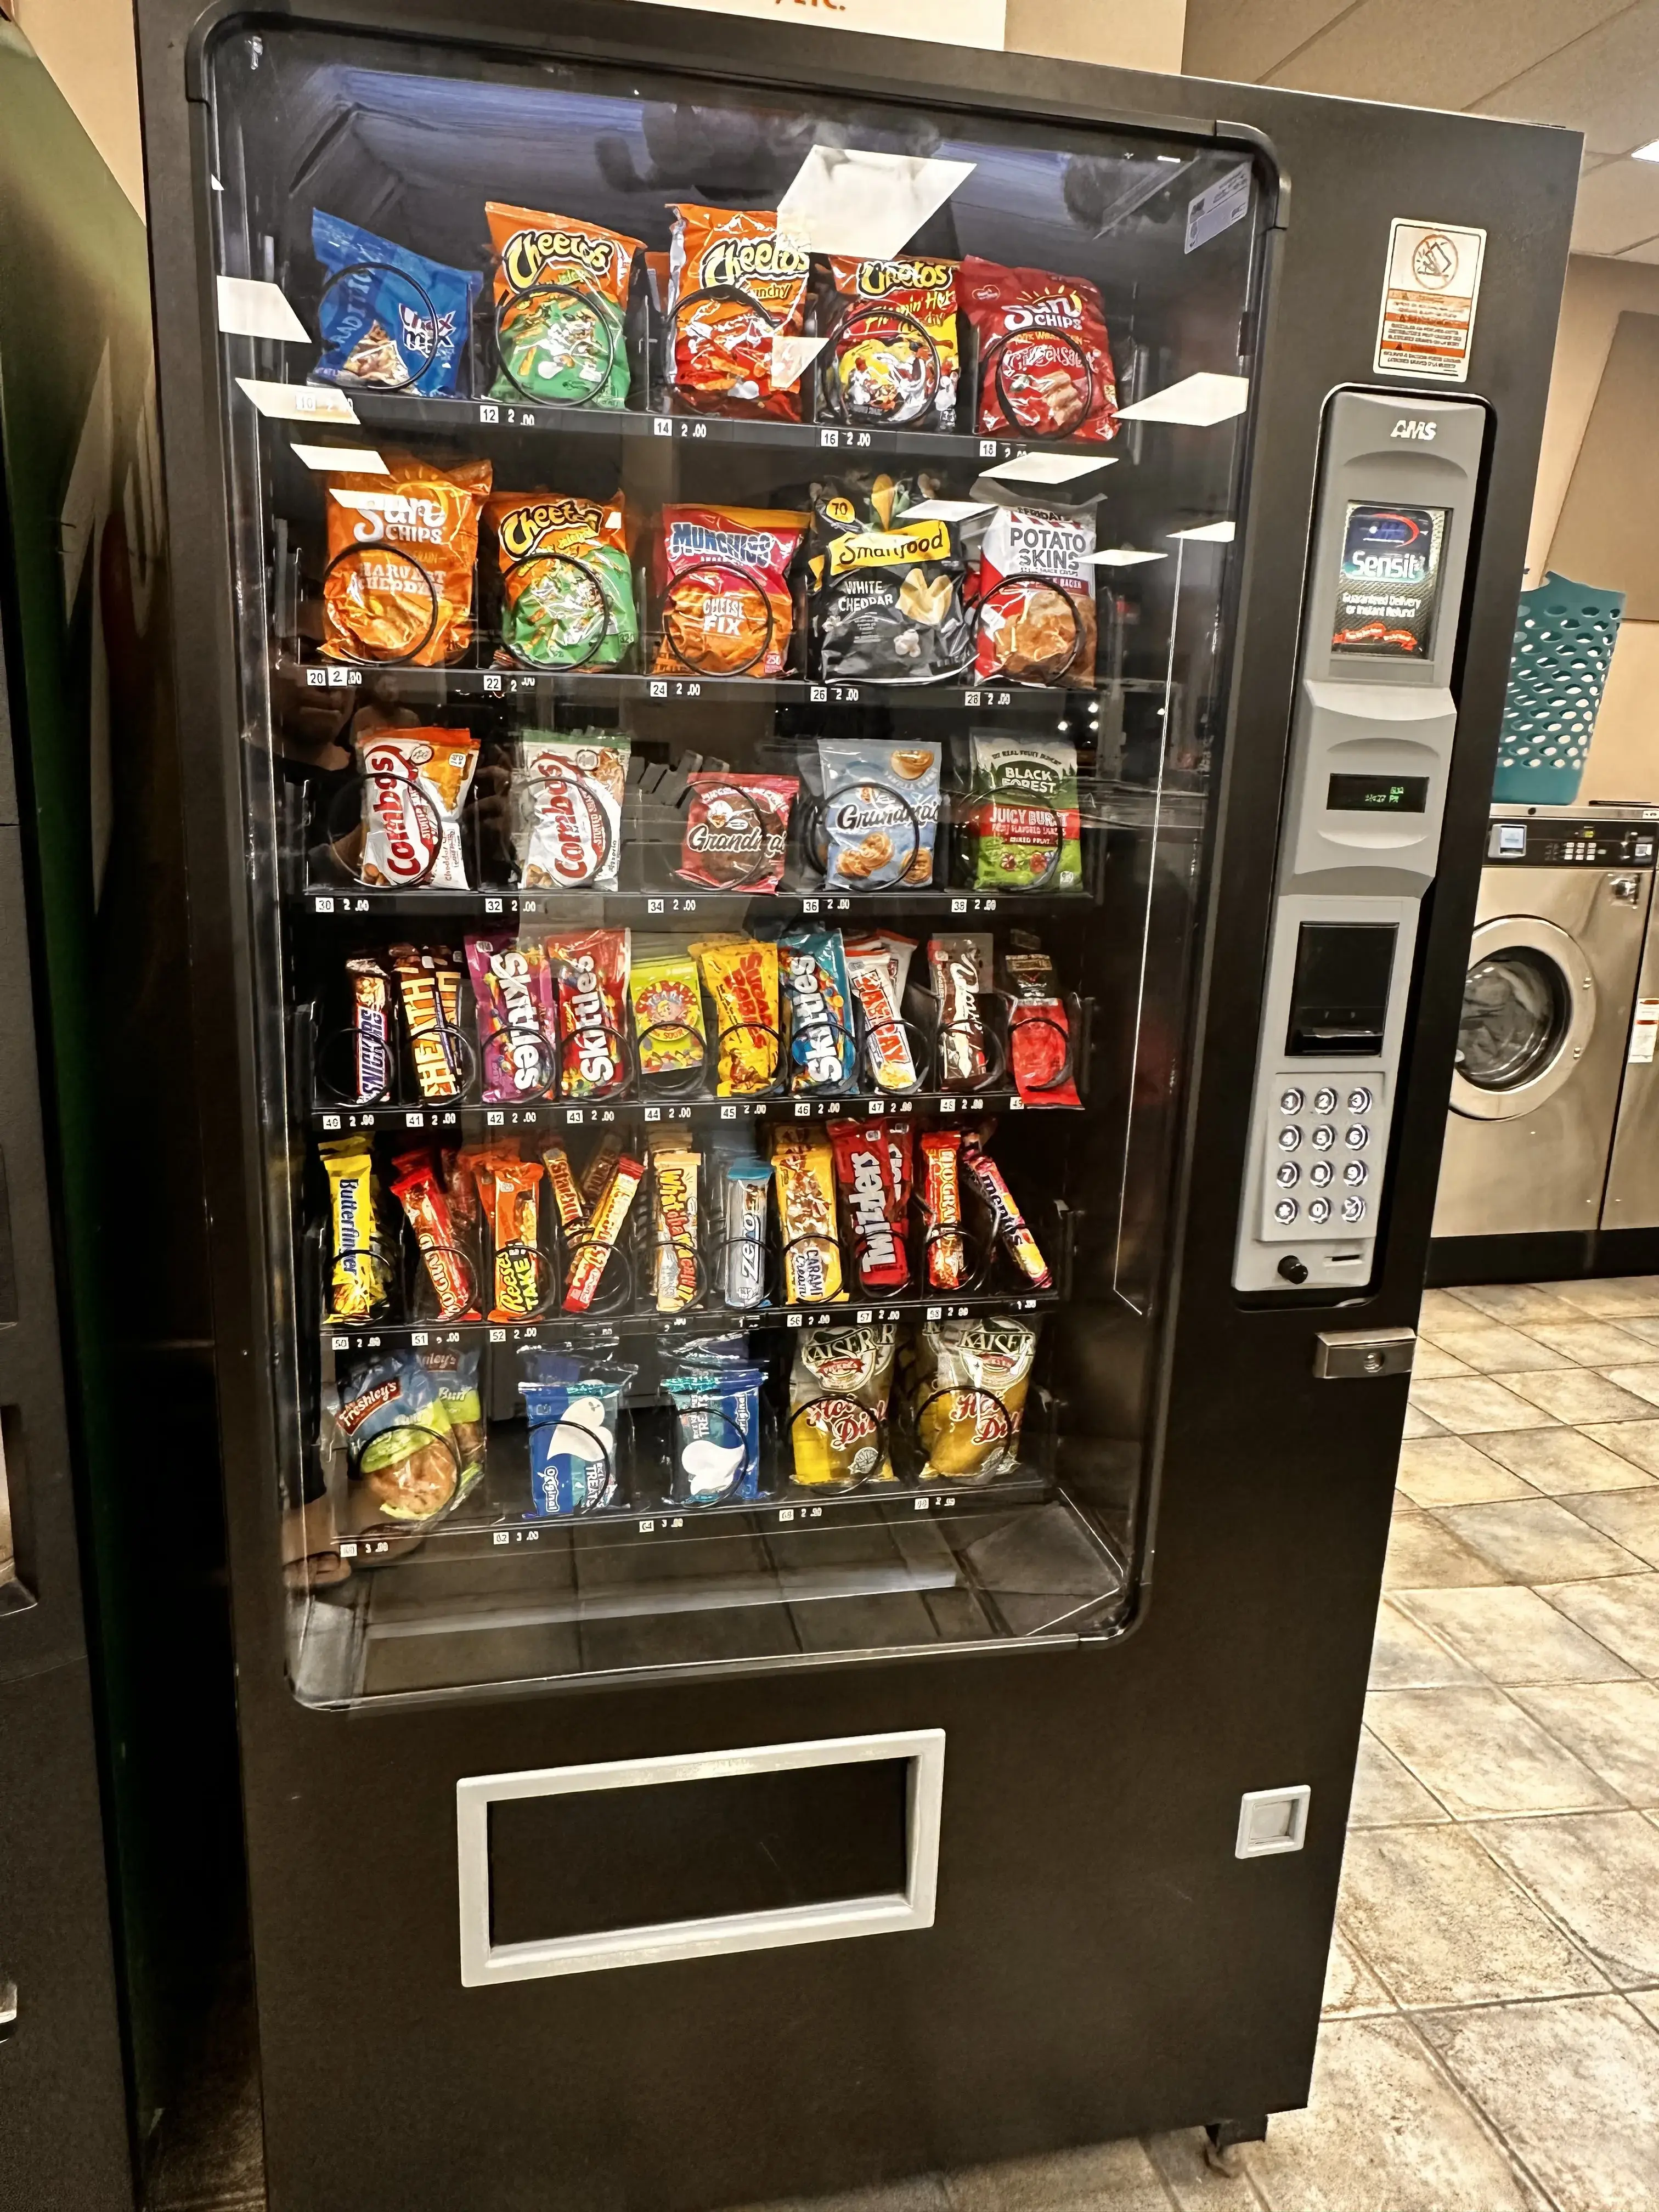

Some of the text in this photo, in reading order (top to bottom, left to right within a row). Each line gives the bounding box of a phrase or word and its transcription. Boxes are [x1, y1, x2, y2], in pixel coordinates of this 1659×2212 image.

[506, 232, 612, 289] Cheetos
[704, 240, 810, 288] Cheetos
[1001, 297, 1082, 330] Sun
[1034, 314, 1083, 330] CHIPS
[483, 409, 496, 422] 12
[658, 422, 669, 433] 14
[1390, 420, 1437, 441] AMS
[824, 433, 836, 444] 16
[982, 444, 994, 455] 18
[832, 503, 848, 515] 70
[385, 524, 443, 545] CHIPS
[1010, 527, 1086, 553] POTATO
[673, 523, 771, 566] MUNCHIES
[1018, 548, 1080, 571] SKINS
[1352, 550, 1417, 579] Sensit
[844, 580, 885, 595] WHITE
[838, 593, 893, 613] CHEDDAR
[703, 616, 741, 636] FIX
[310, 672, 323, 684] 20
[486, 678, 499, 689] 22
[813, 690, 825, 700] 26
[1005, 767, 1052, 781] BLACK
[1001, 777, 1057, 793] FOREST
[371, 757, 421, 876] Combos
[538, 764, 588, 879] Combos
[989, 804, 1069, 827] JUICY BURT
[318, 900, 332, 910] 30
[487, 900, 500, 911] 32
[650, 902, 662, 911] 34
[805, 901, 817, 911] 36
[740, 951, 773, 1026] SUGAR
[491, 952, 543, 1091] Skittles
[572, 955, 614, 1081] Skittles
[790, 955, 843, 1083] Skittles
[360, 1008, 384, 1096] SNICKERS
[871, 1102, 883, 1111] 47
[1285, 1094, 1362, 1108] 1 2 3
[569, 1112, 581, 1122] 43
[646, 1110, 659, 1119] 44
[723, 1108, 735, 1118] 45
[797, 1105, 809, 1114] 46
[489, 1114, 501, 1123] 42
[1283, 1130, 1361, 1144] 4 5 6
[1281, 1166, 1357, 1181] 7 8 9
[340, 1178, 360, 1276] Butterfinger
[741, 1212, 760, 1284] Zero
[516, 1257, 538, 1311] TAKE
[860, 1313, 870, 1321] 57
[415, 1336, 426, 1344] 51
[493, 1331, 504, 1340] 52
[960, 1331, 1034, 1356] KAISER
[807, 1329, 877, 1363] KAISER
[698, 1393, 710, 1438] TRETS
[736, 1394, 749, 1435] riginal
